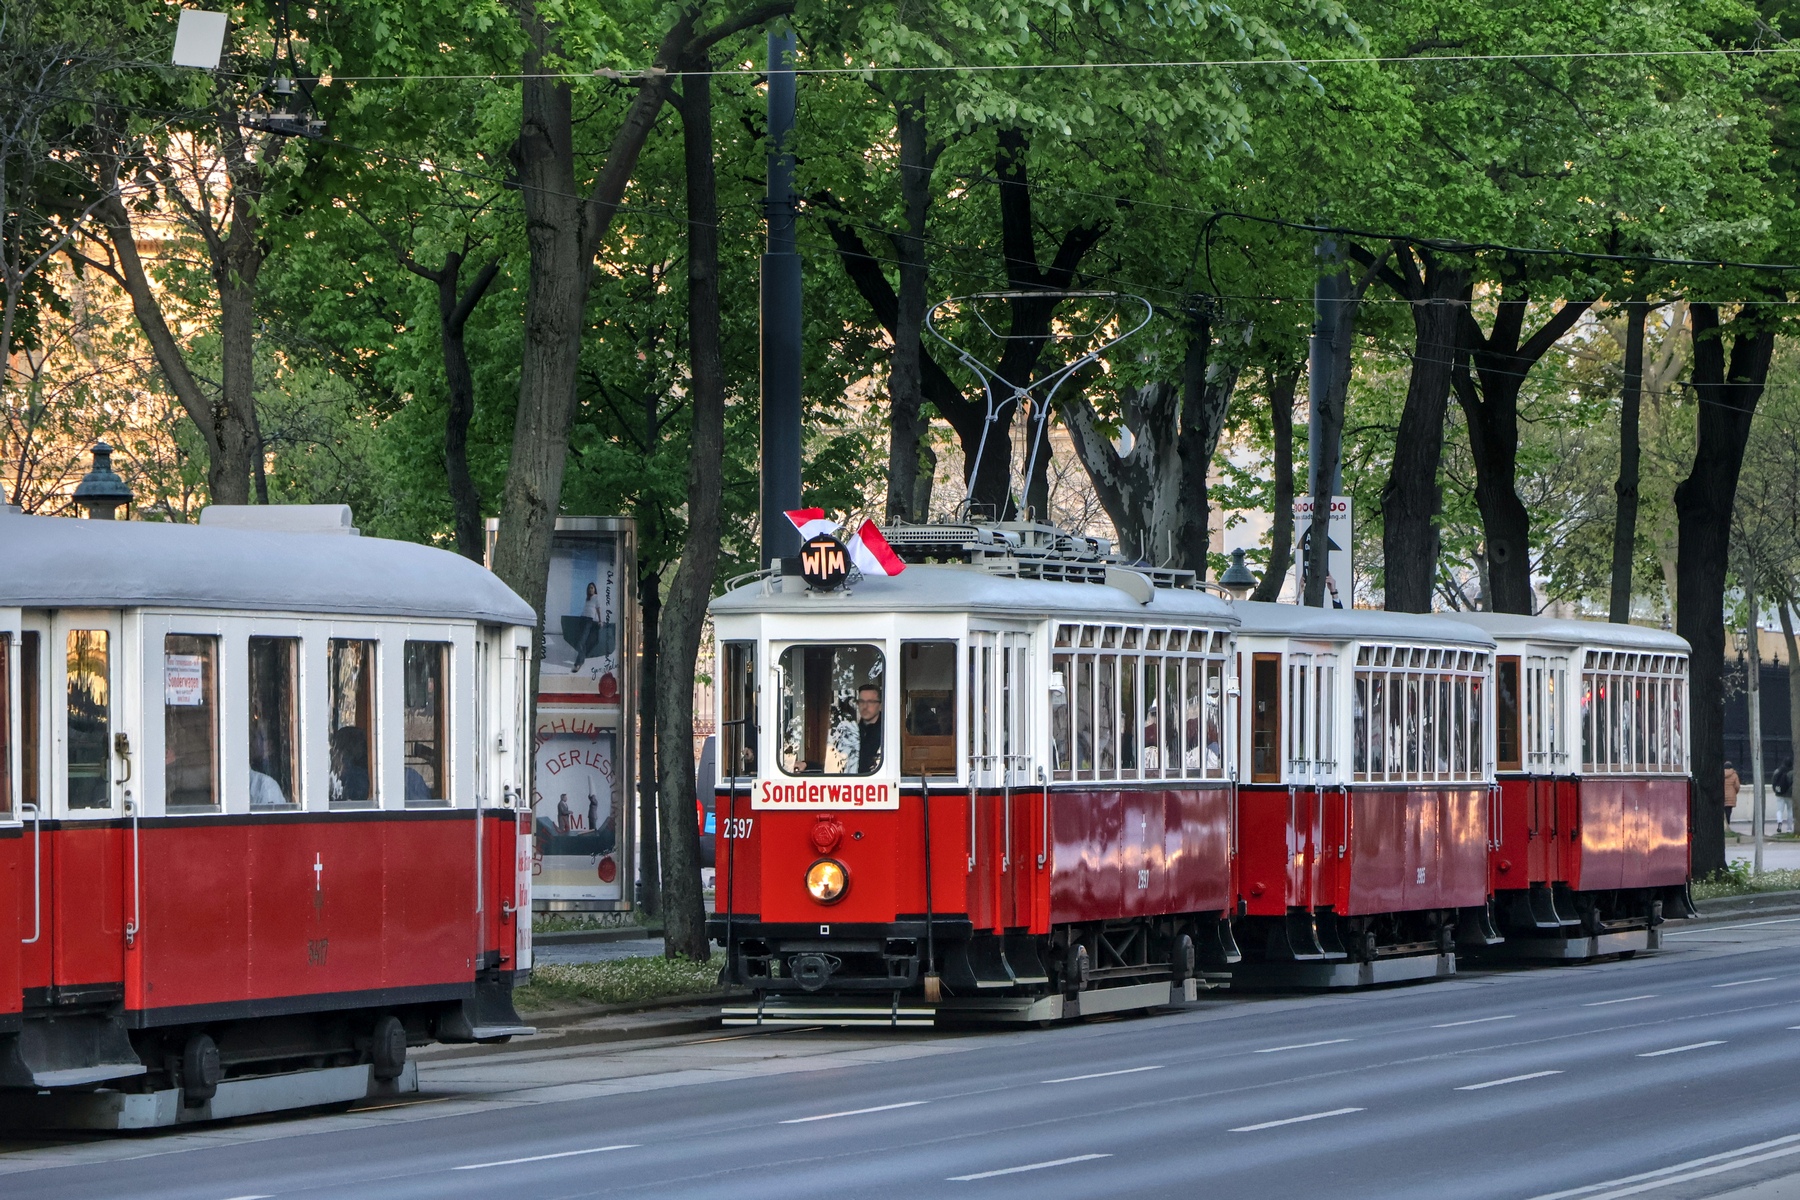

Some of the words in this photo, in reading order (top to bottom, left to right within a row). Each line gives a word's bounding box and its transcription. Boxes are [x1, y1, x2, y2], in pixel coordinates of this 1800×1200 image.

[801, 542, 846, 580] WTM
[545, 749, 581, 775] DER
[762, 780, 888, 805] Sonderwagen
[723, 817, 753, 839] 2597
